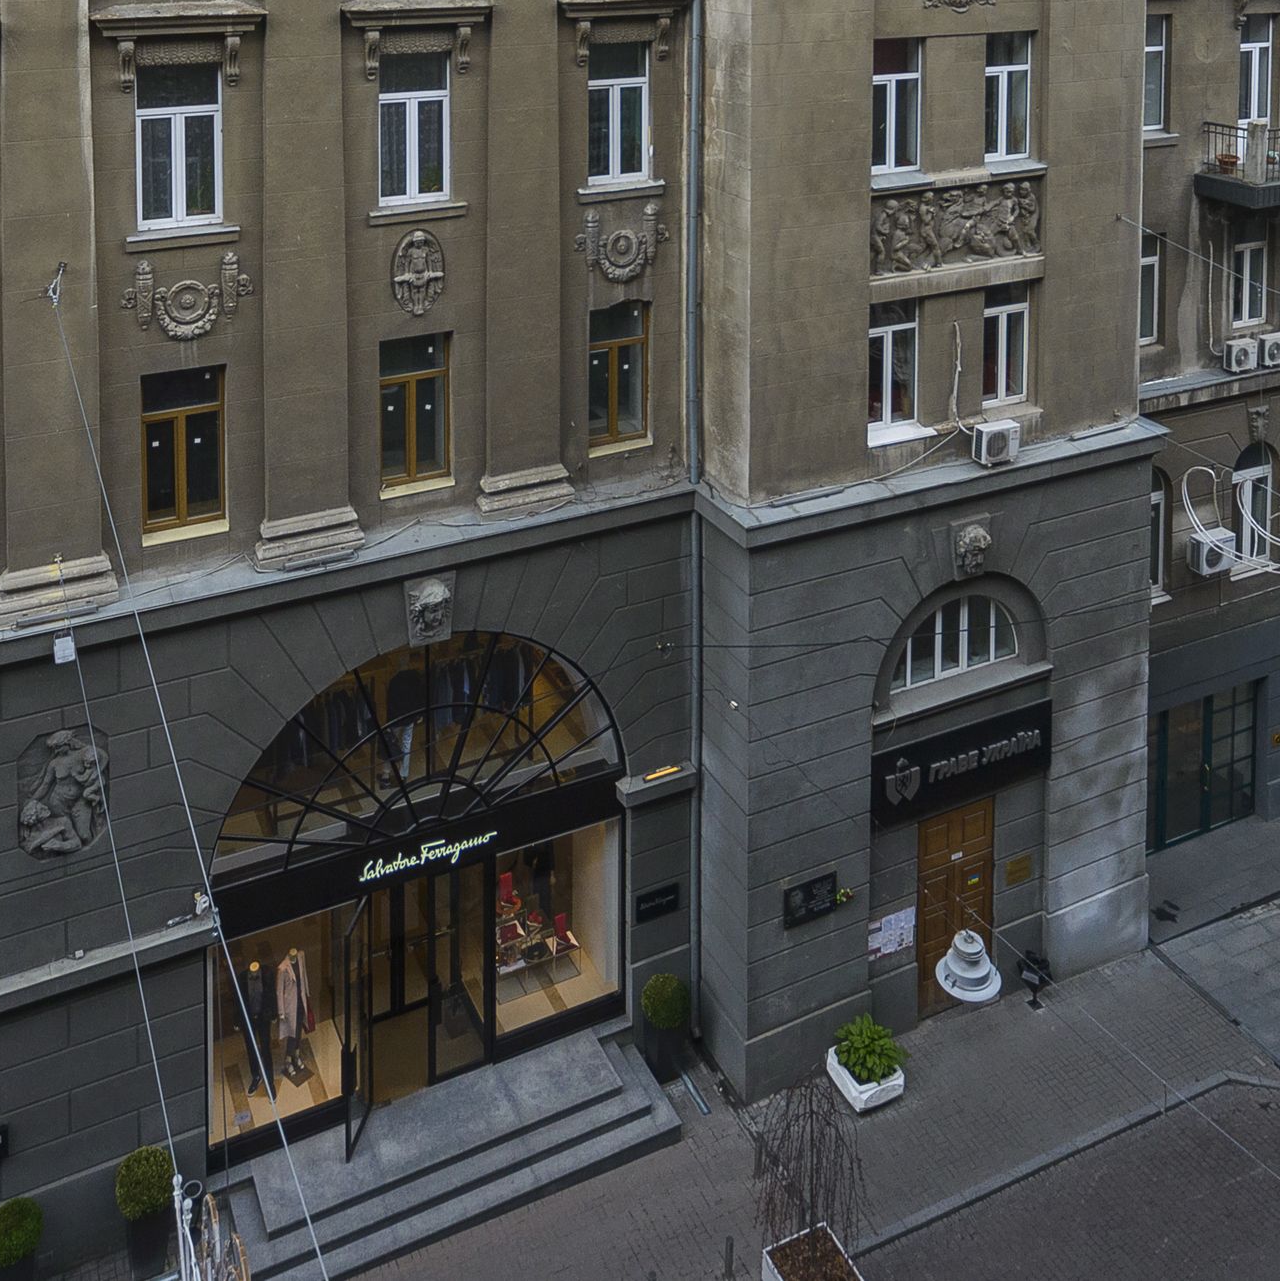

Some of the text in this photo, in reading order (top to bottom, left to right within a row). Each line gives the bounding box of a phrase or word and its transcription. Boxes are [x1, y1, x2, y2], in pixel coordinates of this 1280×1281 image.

[929, 729, 1041, 783] ГРАВЕ УКРАЇНА
[359, 831, 498, 882] Salvatore Ferragamo
